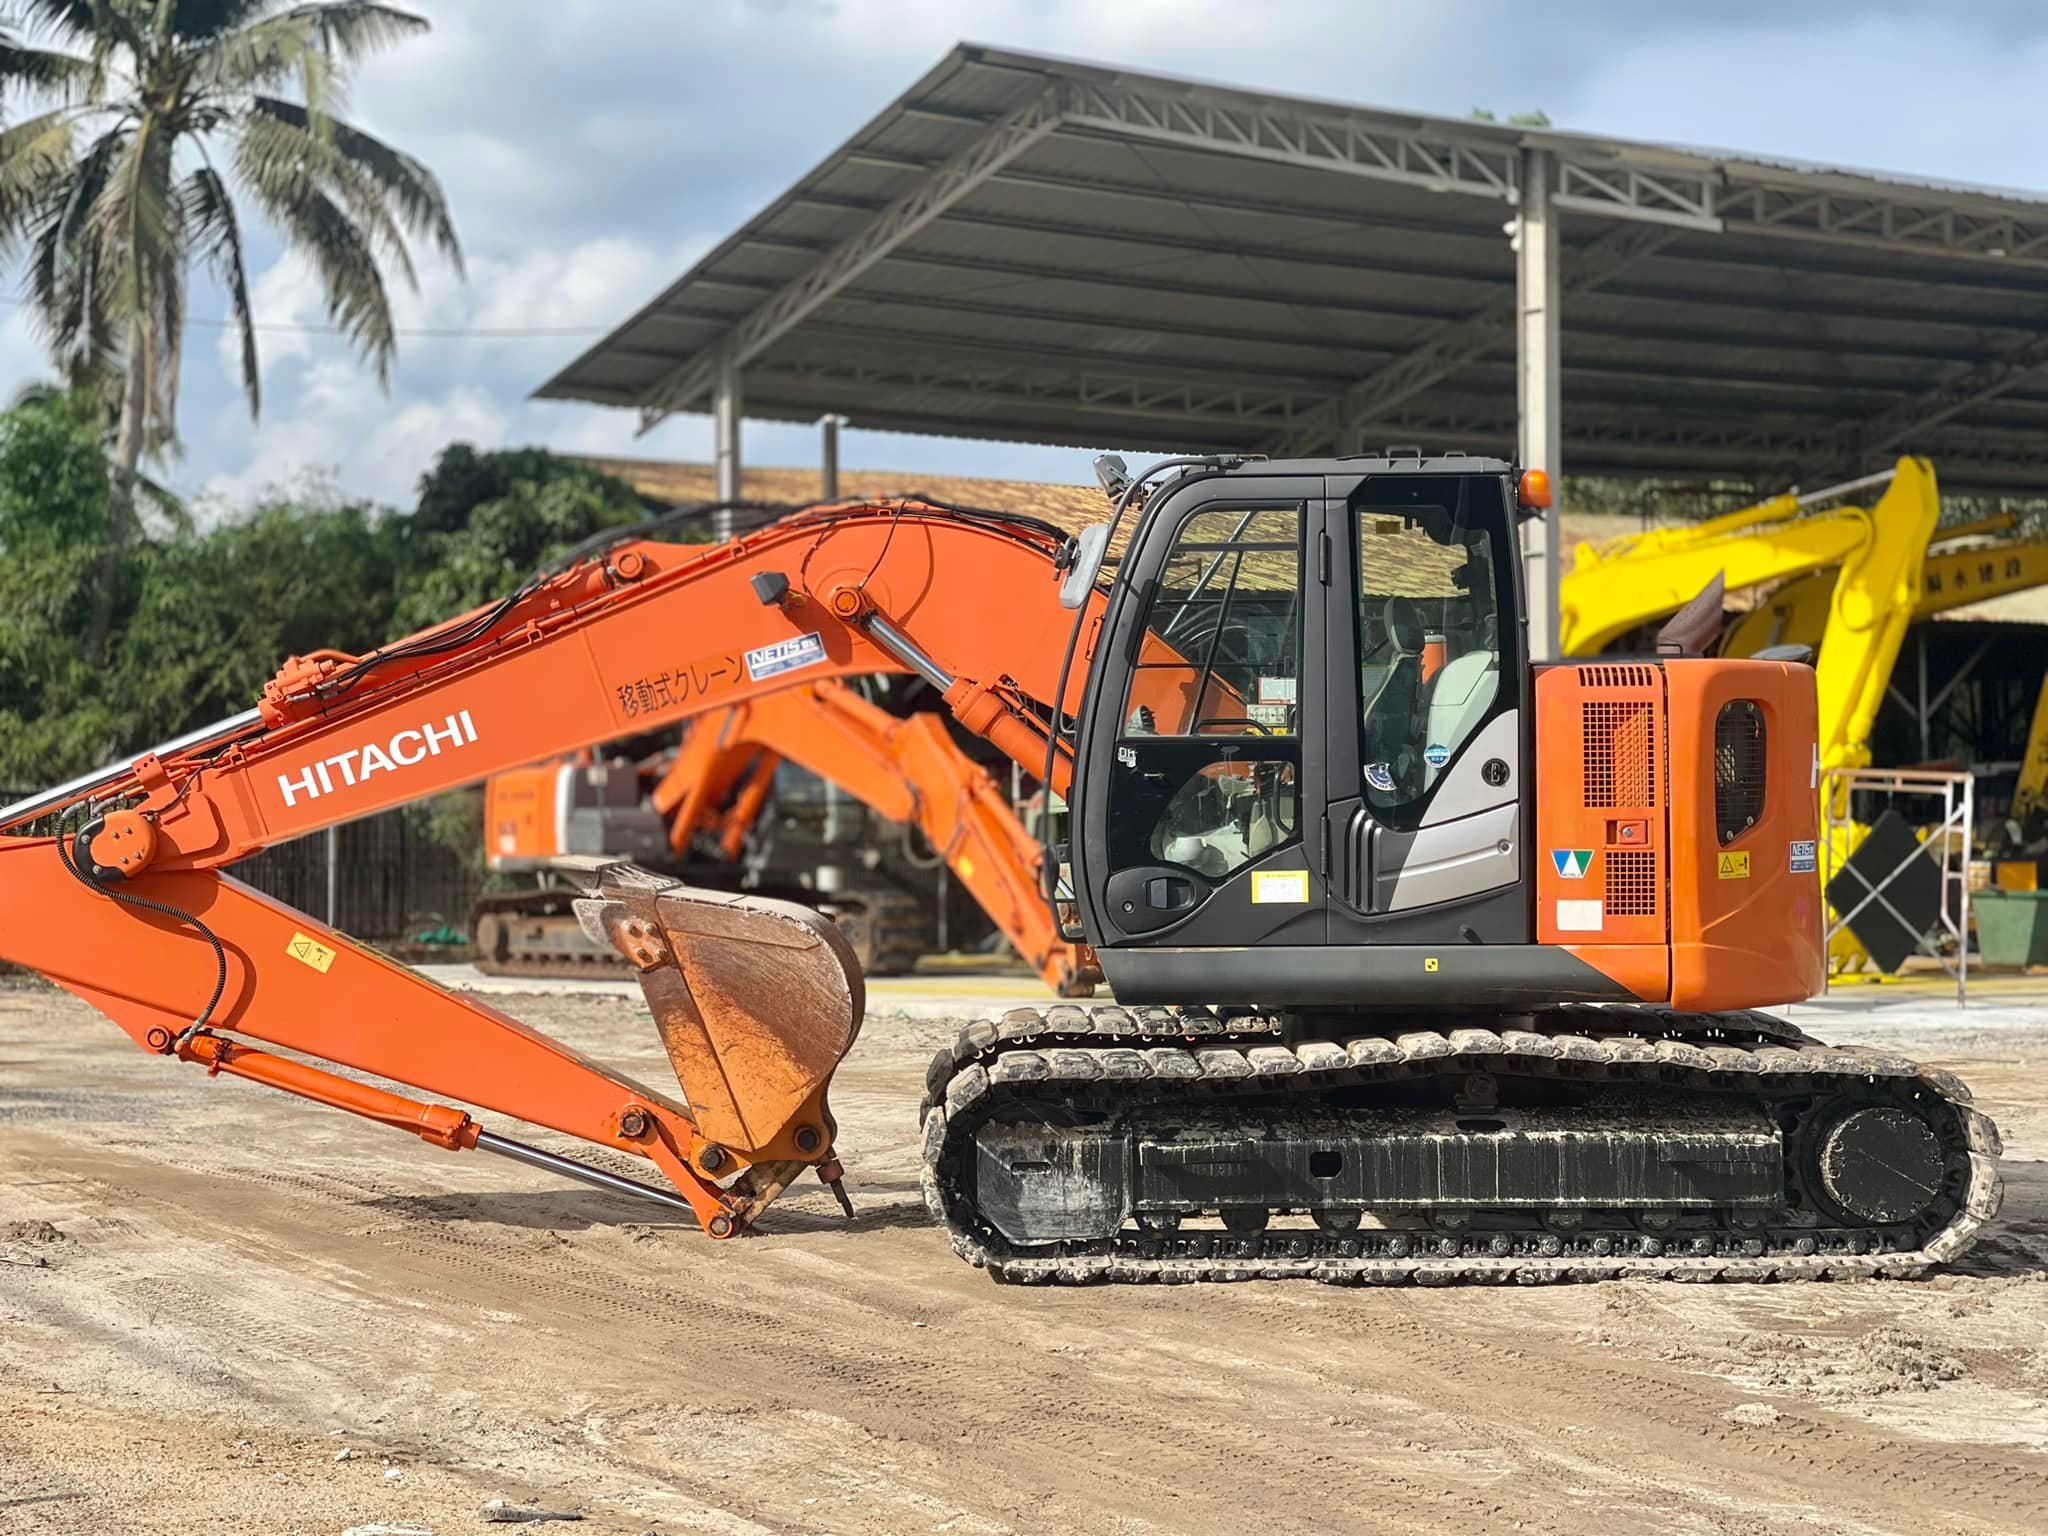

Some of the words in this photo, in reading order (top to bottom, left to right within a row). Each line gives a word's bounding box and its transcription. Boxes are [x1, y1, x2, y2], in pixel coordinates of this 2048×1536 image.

[751, 638, 800, 664] NETIS
[616, 655, 743, 719] 移動式クレーン
[277, 709, 479, 808] HITACHI
